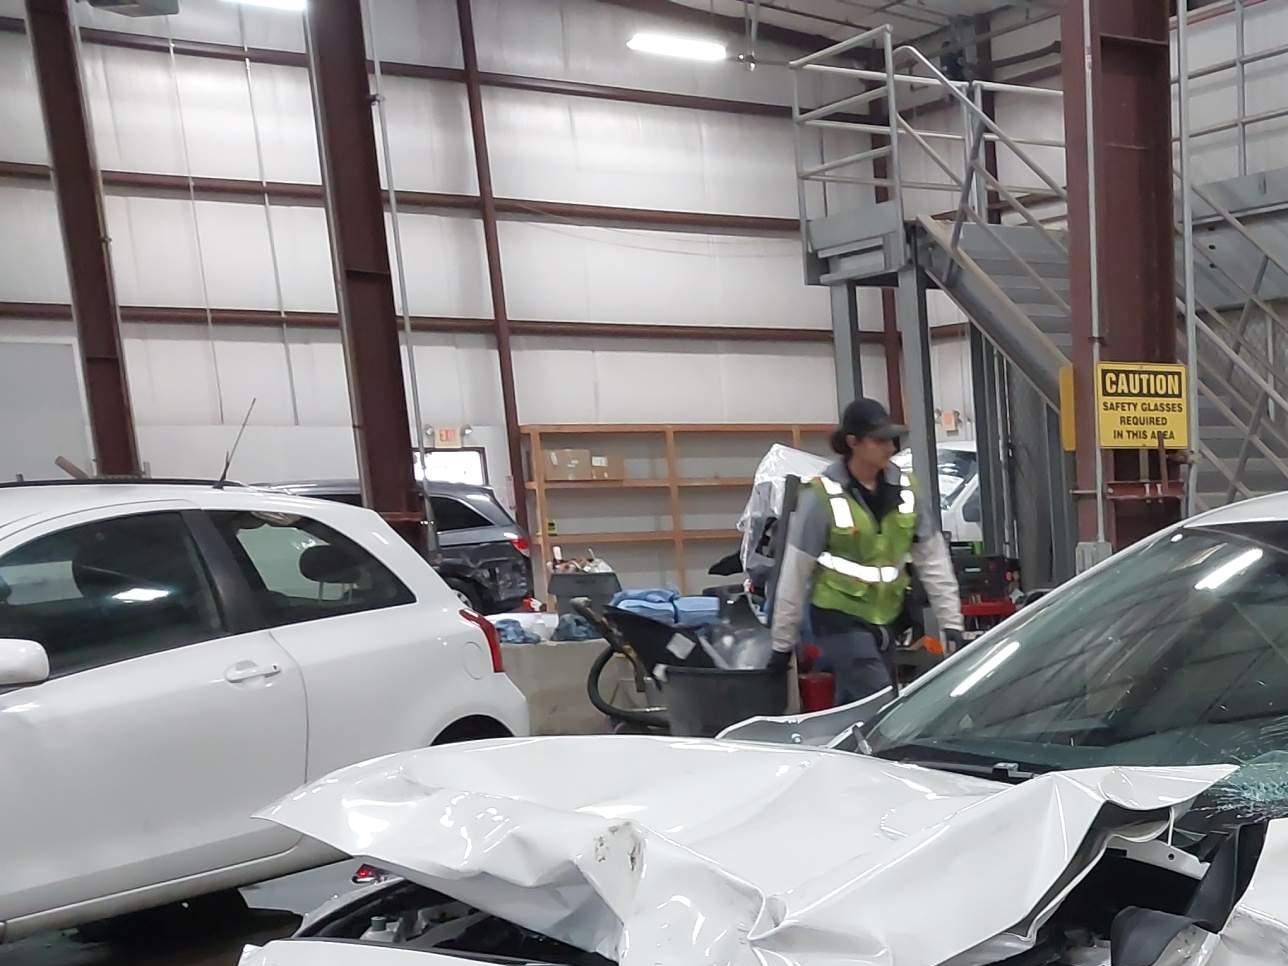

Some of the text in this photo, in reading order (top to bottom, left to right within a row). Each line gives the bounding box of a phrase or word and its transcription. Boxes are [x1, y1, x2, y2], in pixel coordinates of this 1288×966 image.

[1105, 373, 1179, 394] CAUTION
[1103, 402, 1183, 412] SAFETY GLASSES
[1120, 416, 1168, 426] REQUIRED
[1113, 430, 1123, 439] IN
[1126, 430, 1148, 440] THIS
